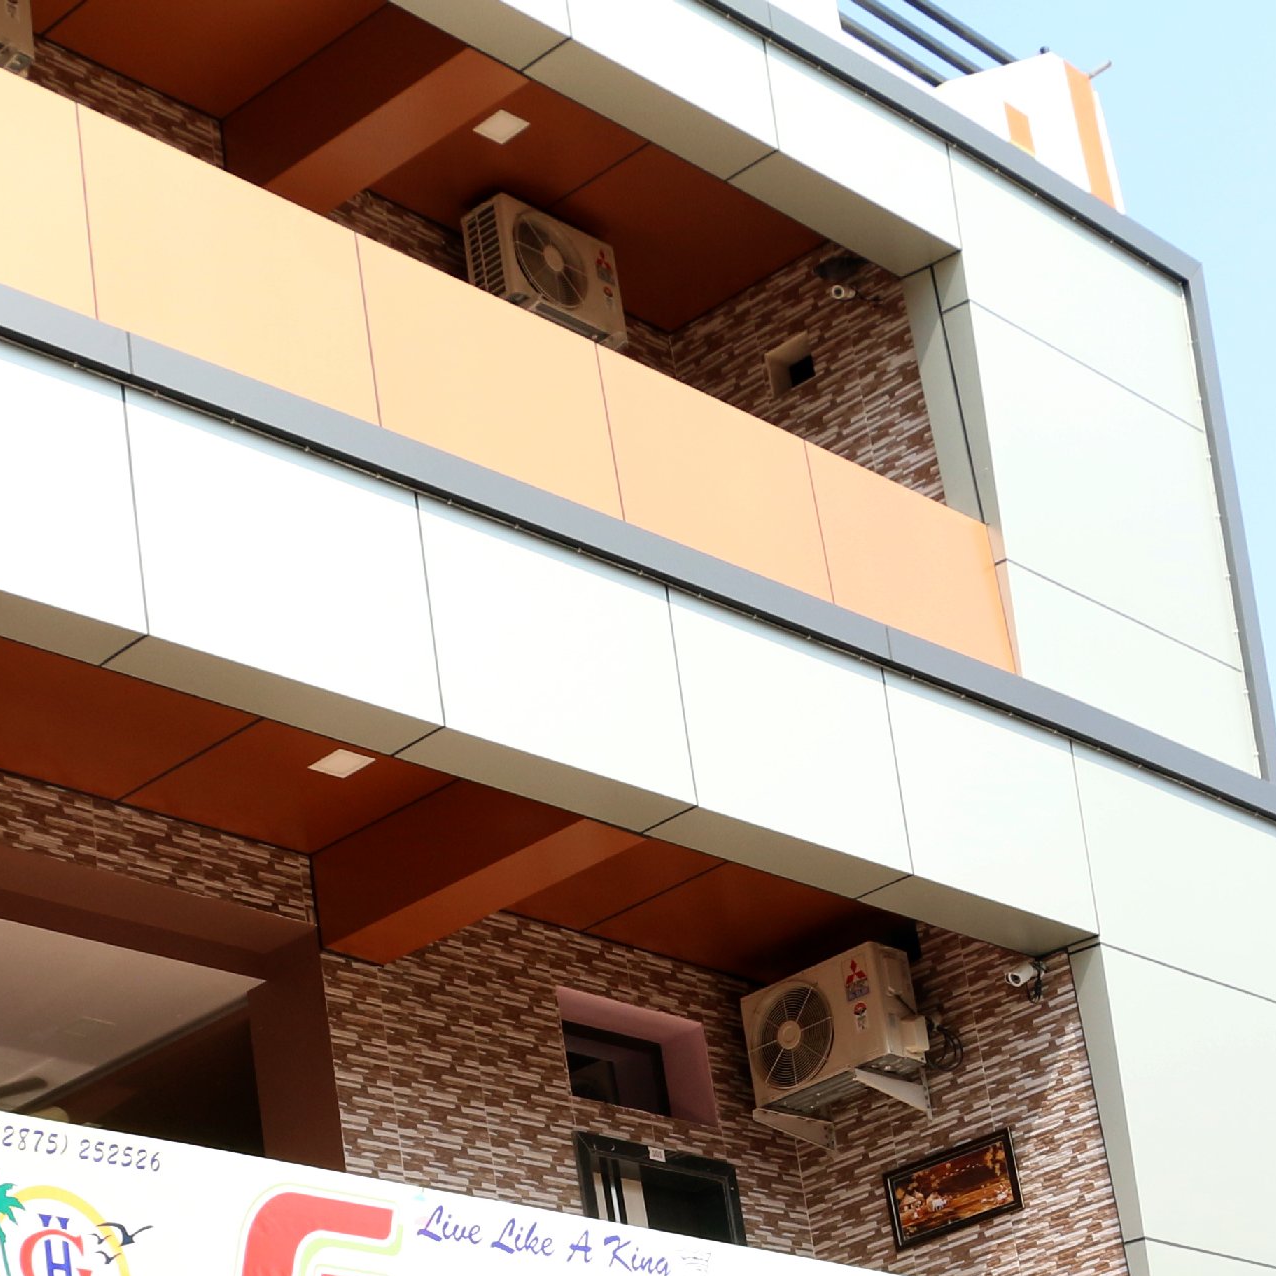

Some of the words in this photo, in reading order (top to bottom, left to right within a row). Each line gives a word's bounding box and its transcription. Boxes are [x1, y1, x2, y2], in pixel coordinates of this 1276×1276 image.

[78, 1137, 162, 1172] 252526
[417, 1204, 482, 1244] Live
[491, 1218, 554, 1256] Like
[567, 1231, 593, 1262] A
